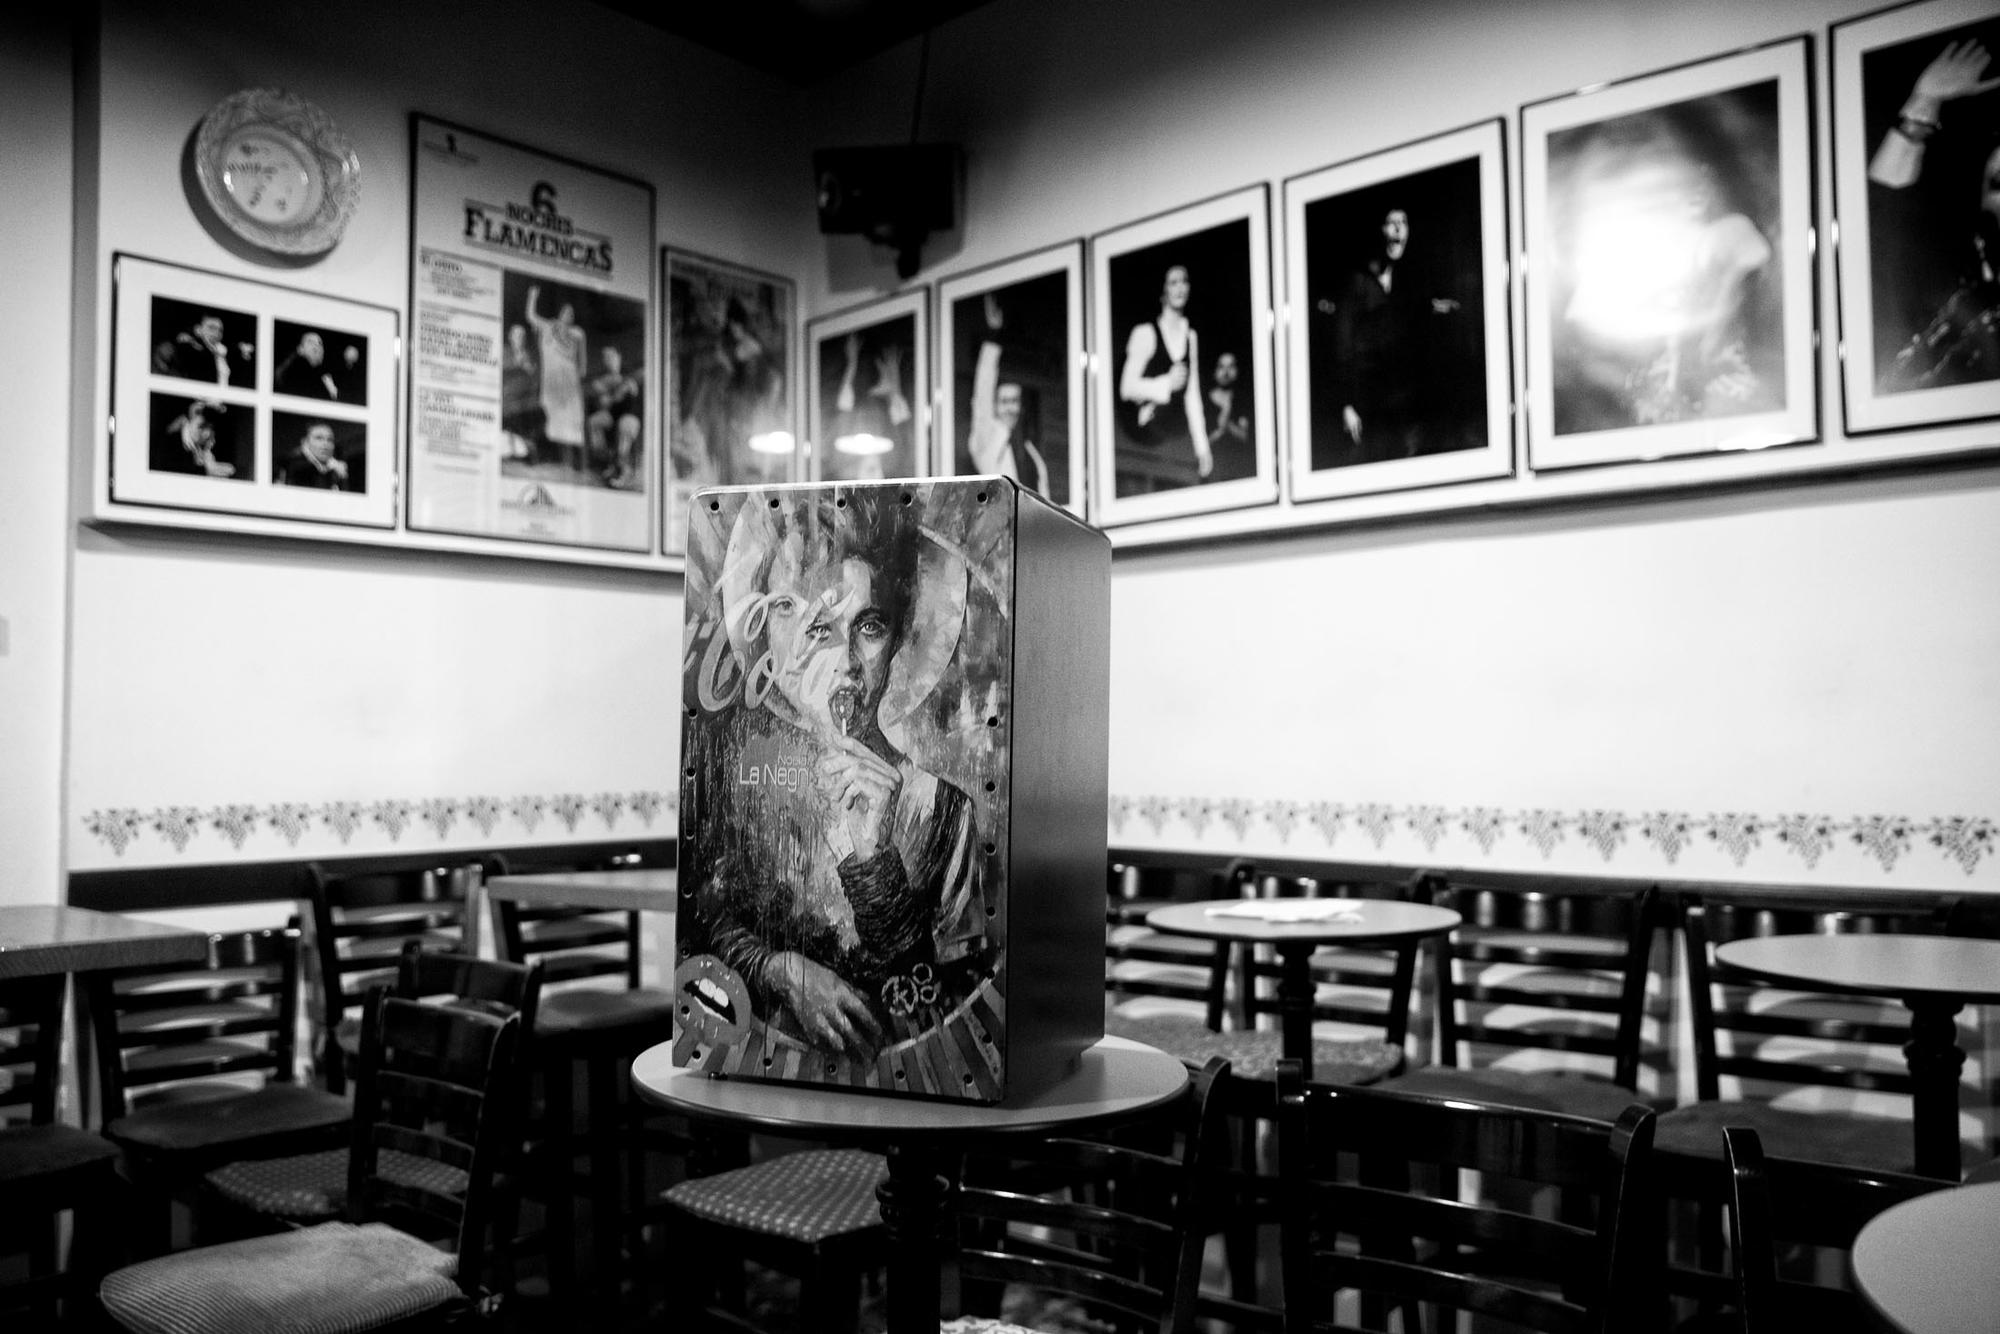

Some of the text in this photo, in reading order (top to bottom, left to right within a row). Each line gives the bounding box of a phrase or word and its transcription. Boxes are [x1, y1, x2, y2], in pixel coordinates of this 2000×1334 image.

[531, 179, 557, 217] 6
[465, 206, 613, 272] FLAMENCAS
[739, 763, 760, 785] La
